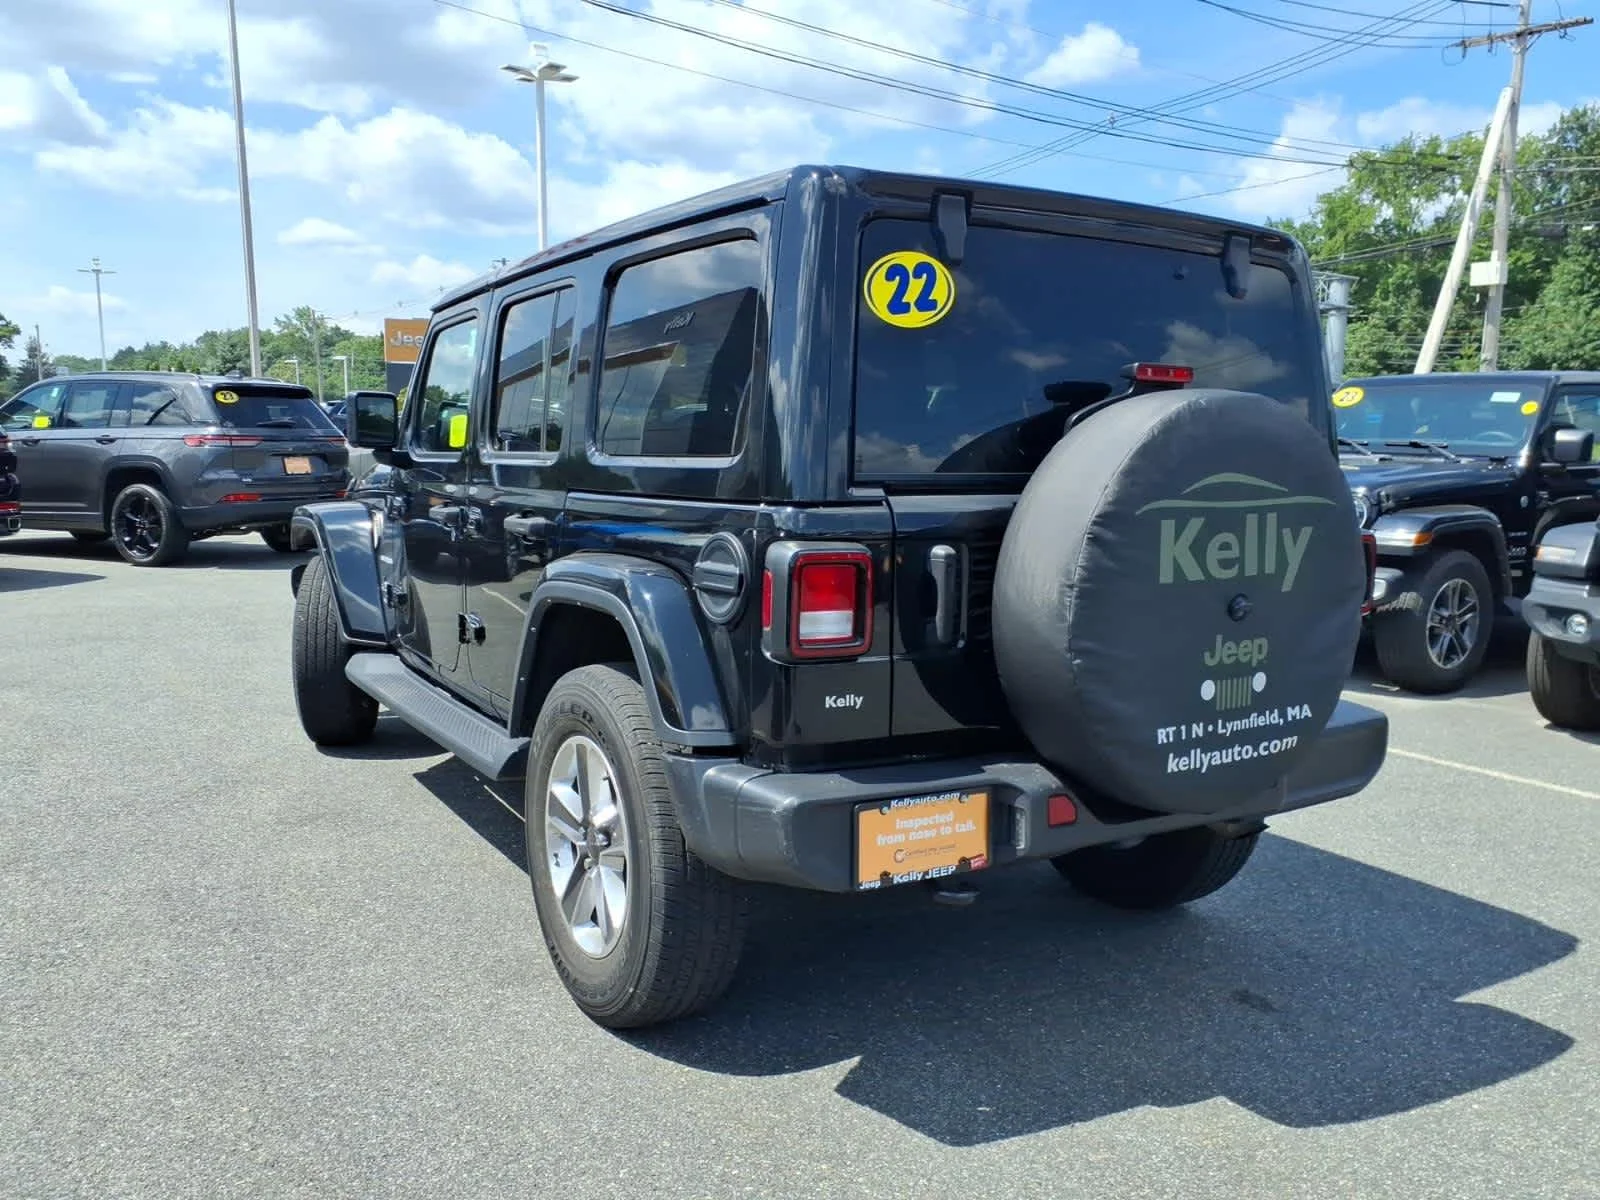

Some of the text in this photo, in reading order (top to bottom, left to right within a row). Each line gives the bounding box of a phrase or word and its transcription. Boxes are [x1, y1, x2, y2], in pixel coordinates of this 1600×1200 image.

[884, 261, 938, 316] 22
[390, 330, 425, 348] Jee
[1158, 511, 1314, 593] Kelly
[1203, 634, 1269, 667] Jeep
[824, 694, 864, 709] Kelly
[1157, 704, 1313, 745] RT 1 N Lynnfield, MA
[1167, 736, 1299, 774] kellyauto.com
[876, 833, 905, 847] from
[940, 824, 953, 836] to
[892, 871, 923, 884] Kelly
[925, 864, 957, 880] JEEP
